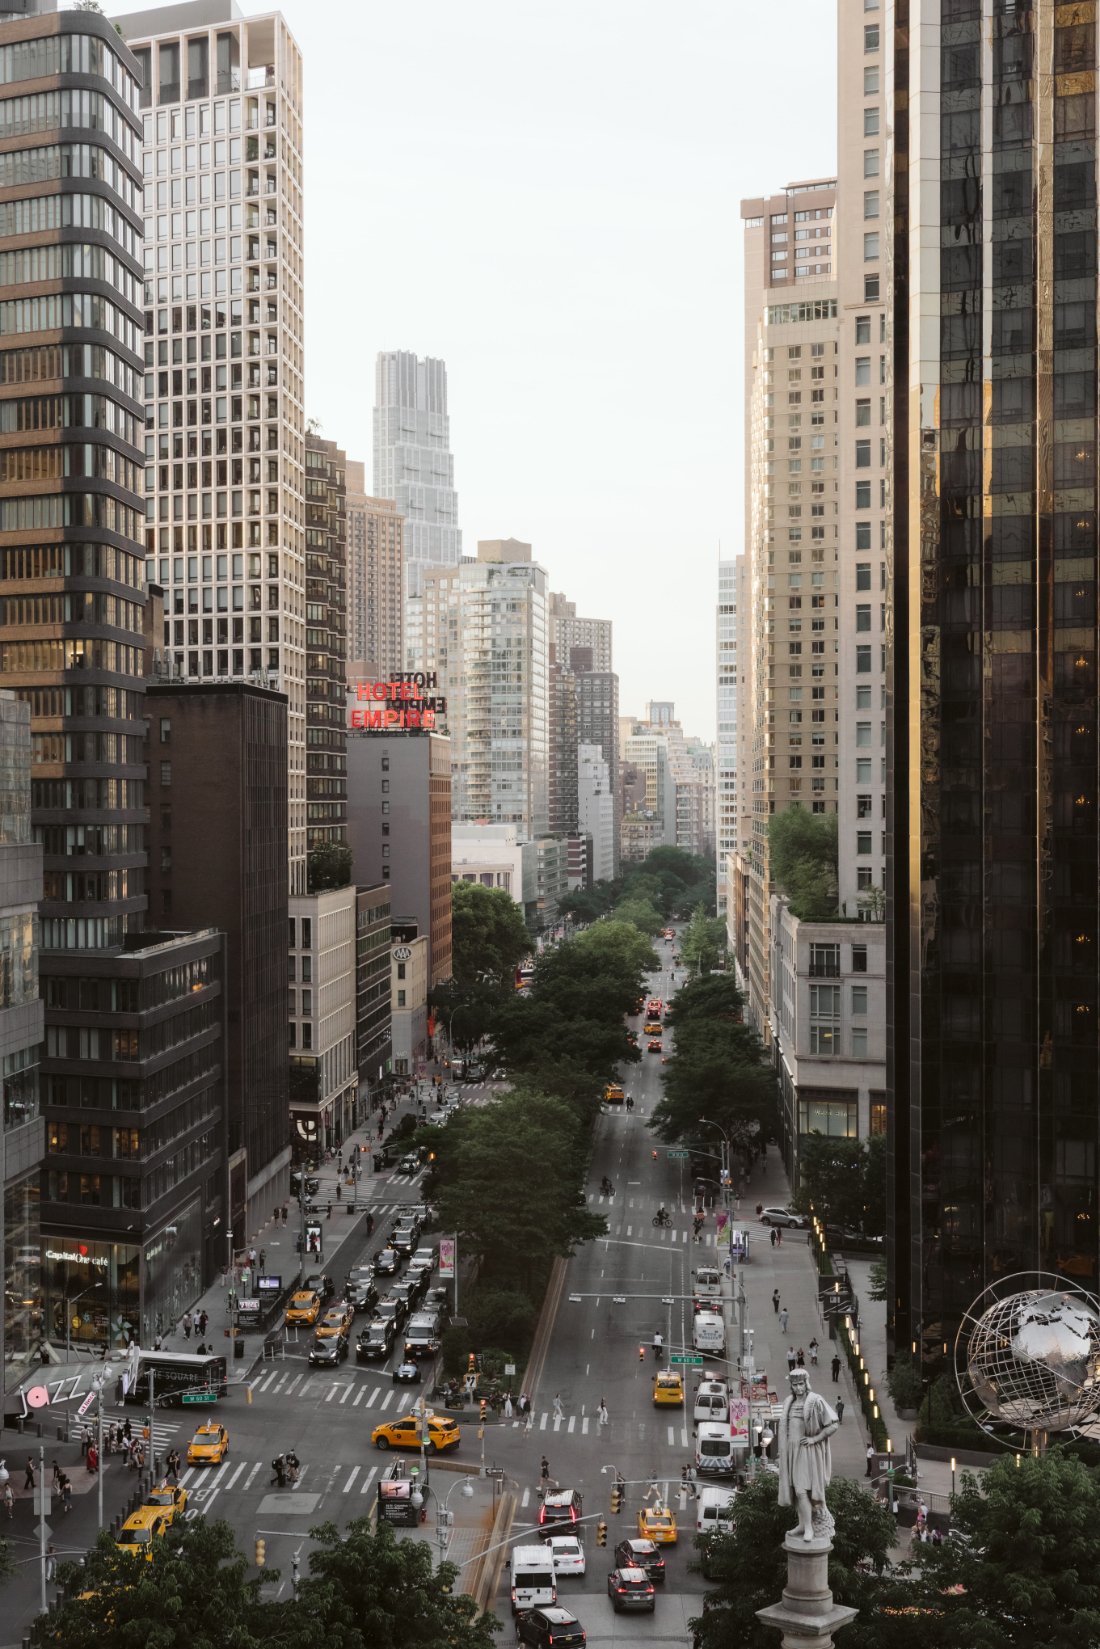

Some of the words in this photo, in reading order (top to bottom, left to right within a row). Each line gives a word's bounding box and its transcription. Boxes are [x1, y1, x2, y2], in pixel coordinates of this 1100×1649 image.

[357, 682, 424, 701] HOTEL
[351, 709, 436, 728] EMPIRE
[396, 948, 410, 959] AAA
[92, 1257, 109, 1266] café
[16, 1375, 86, 1419] jazz
